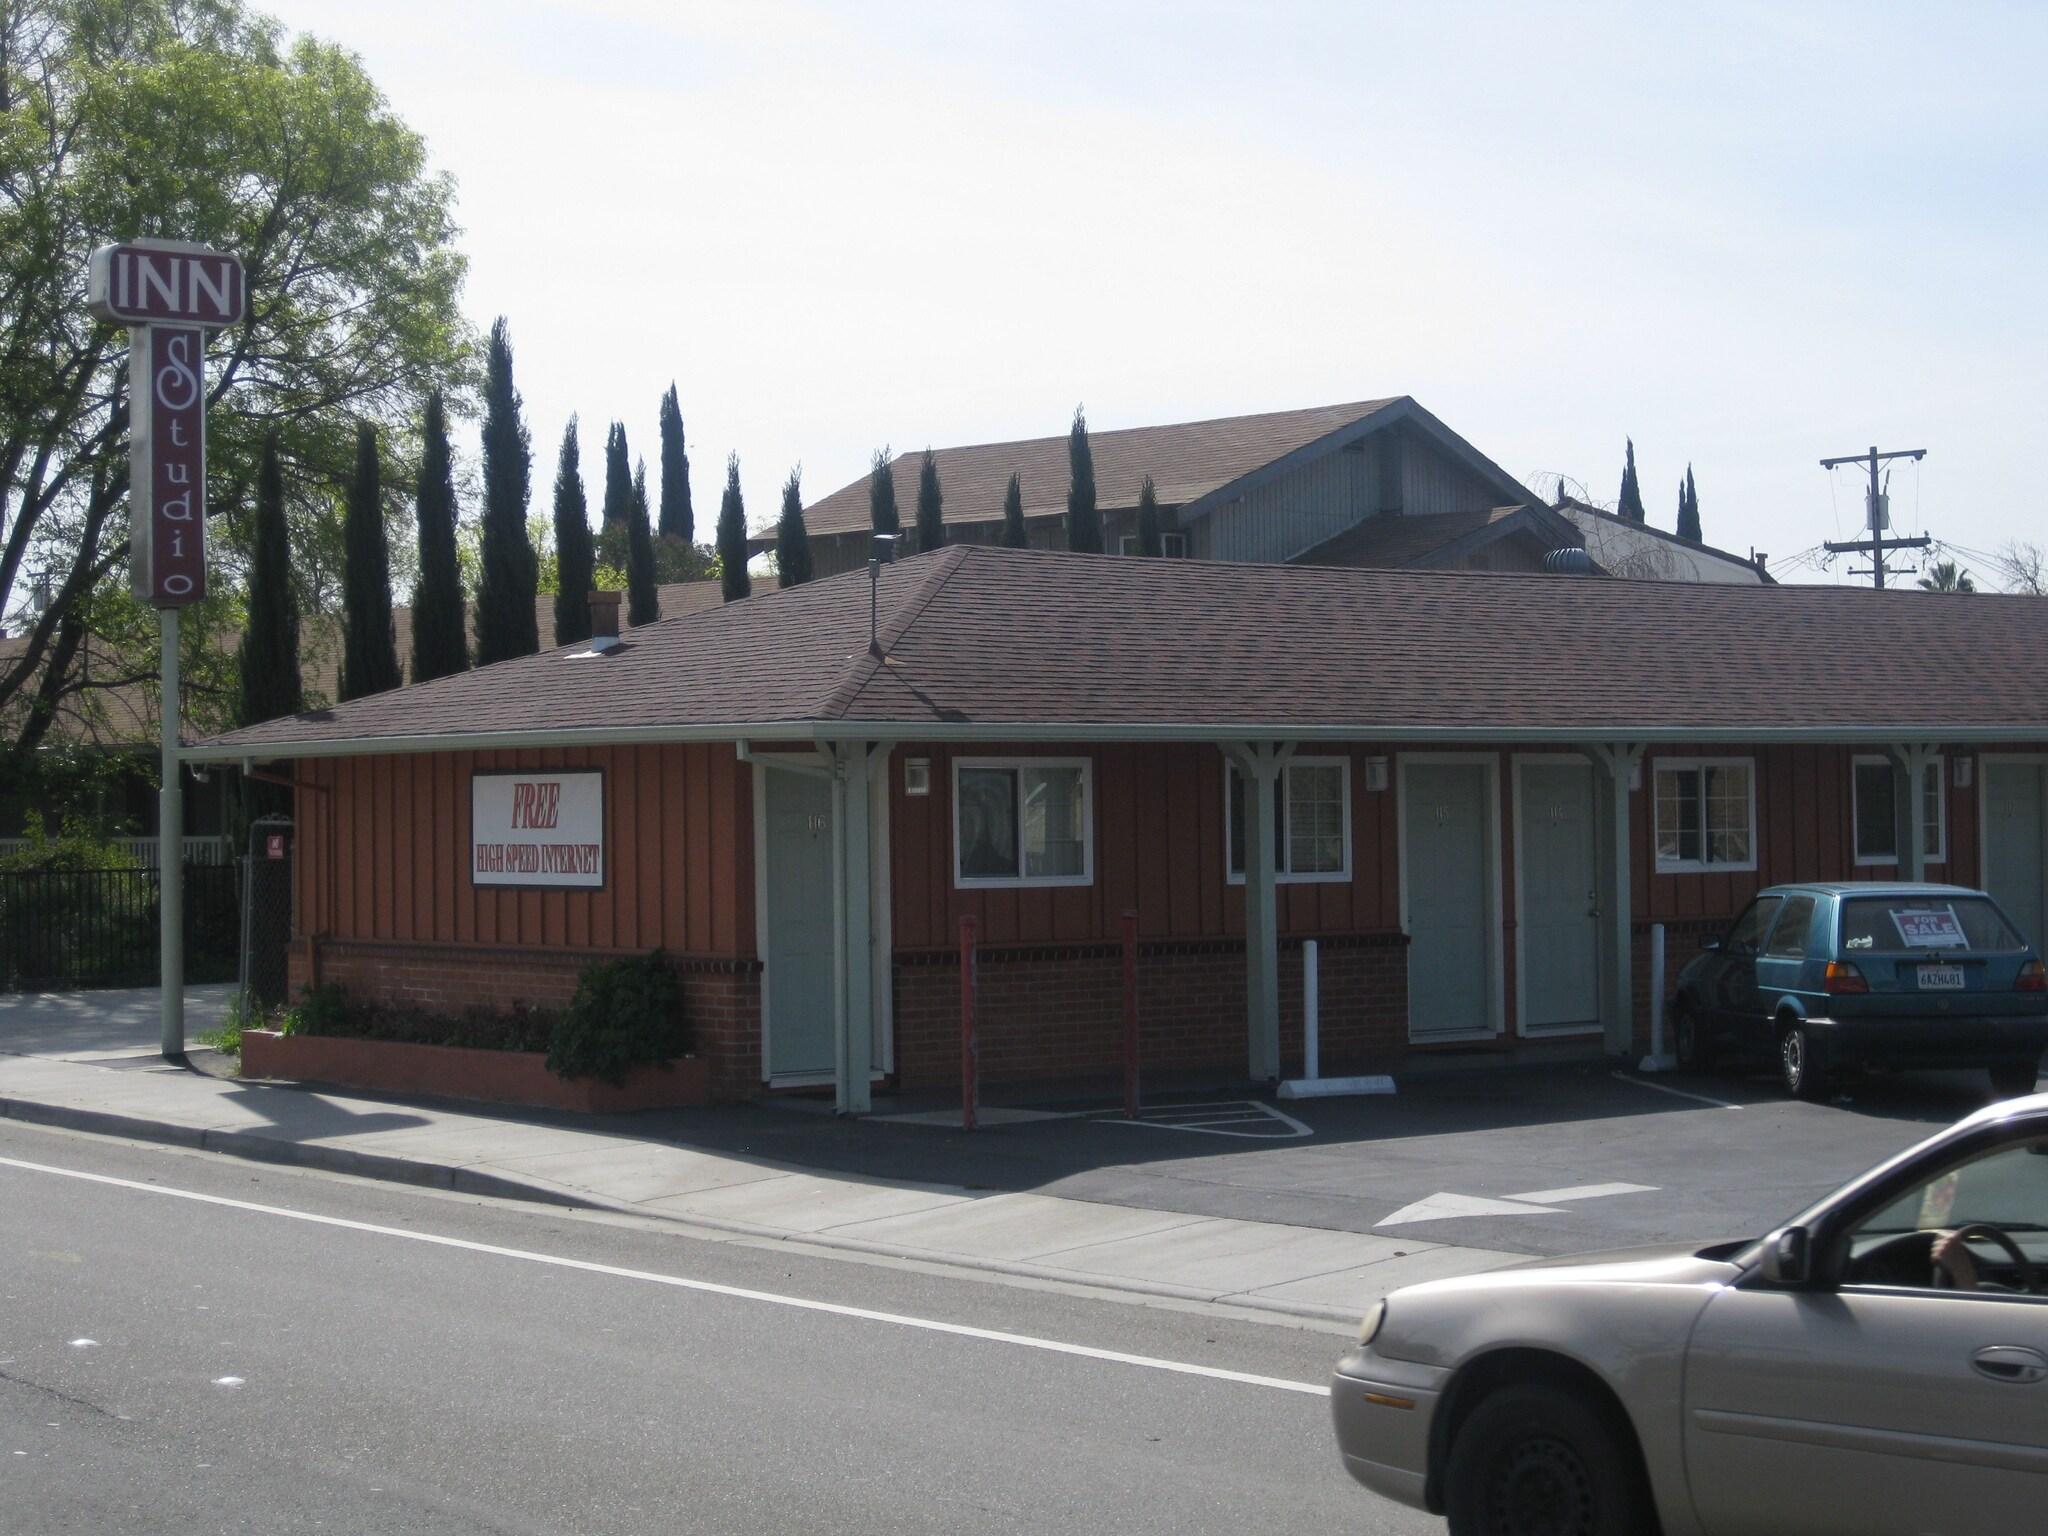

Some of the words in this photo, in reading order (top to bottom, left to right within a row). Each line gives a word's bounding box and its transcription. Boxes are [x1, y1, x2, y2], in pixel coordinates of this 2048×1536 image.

[118, 253, 232, 316] INN
[156, 335, 198, 594] Studio
[511, 782, 560, 829] FREE
[476, 843, 504, 873] HIGH
[505, 843, 539, 873] SPEED
[541, 843, 600, 874] INTERNET
[1904, 924, 1954, 935] SALE
[1912, 916, 1937, 924] FOR
